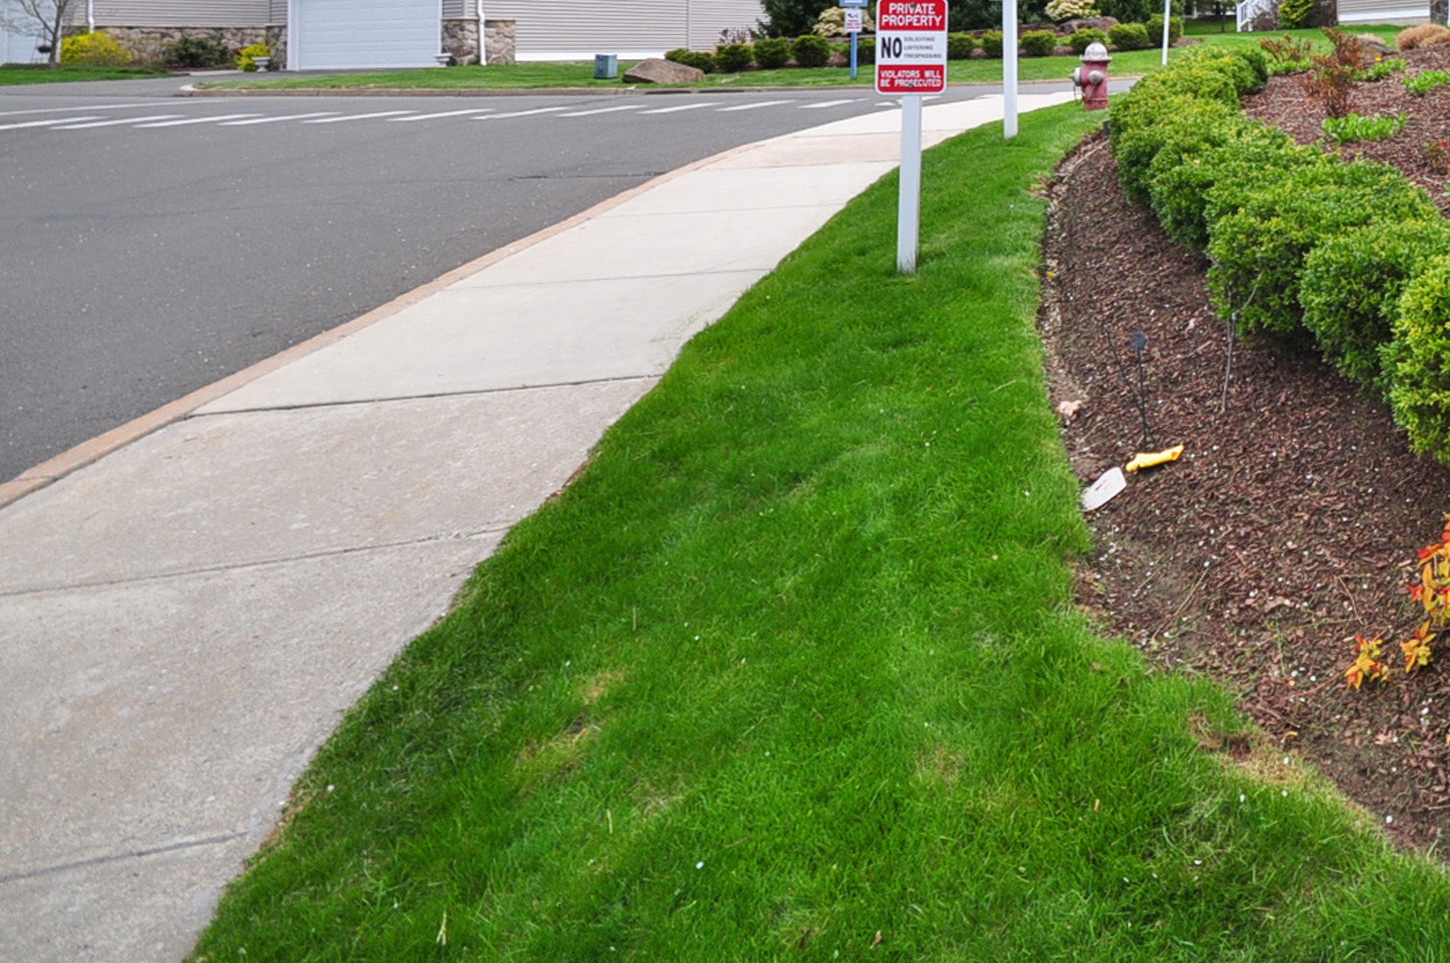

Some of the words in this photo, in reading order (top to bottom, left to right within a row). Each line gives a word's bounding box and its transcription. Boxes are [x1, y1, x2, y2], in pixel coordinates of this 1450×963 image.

[889, 3, 936, 15] PRIVATE
[881, 14, 943, 27] PROPERTY
[881, 37, 902, 59] NO
[880, 70, 920, 78] VIOLATORS
[924, 70, 942, 78] WILL
[880, 79, 891, 87] BE
[894, 79, 942, 87] PROSECUTED
